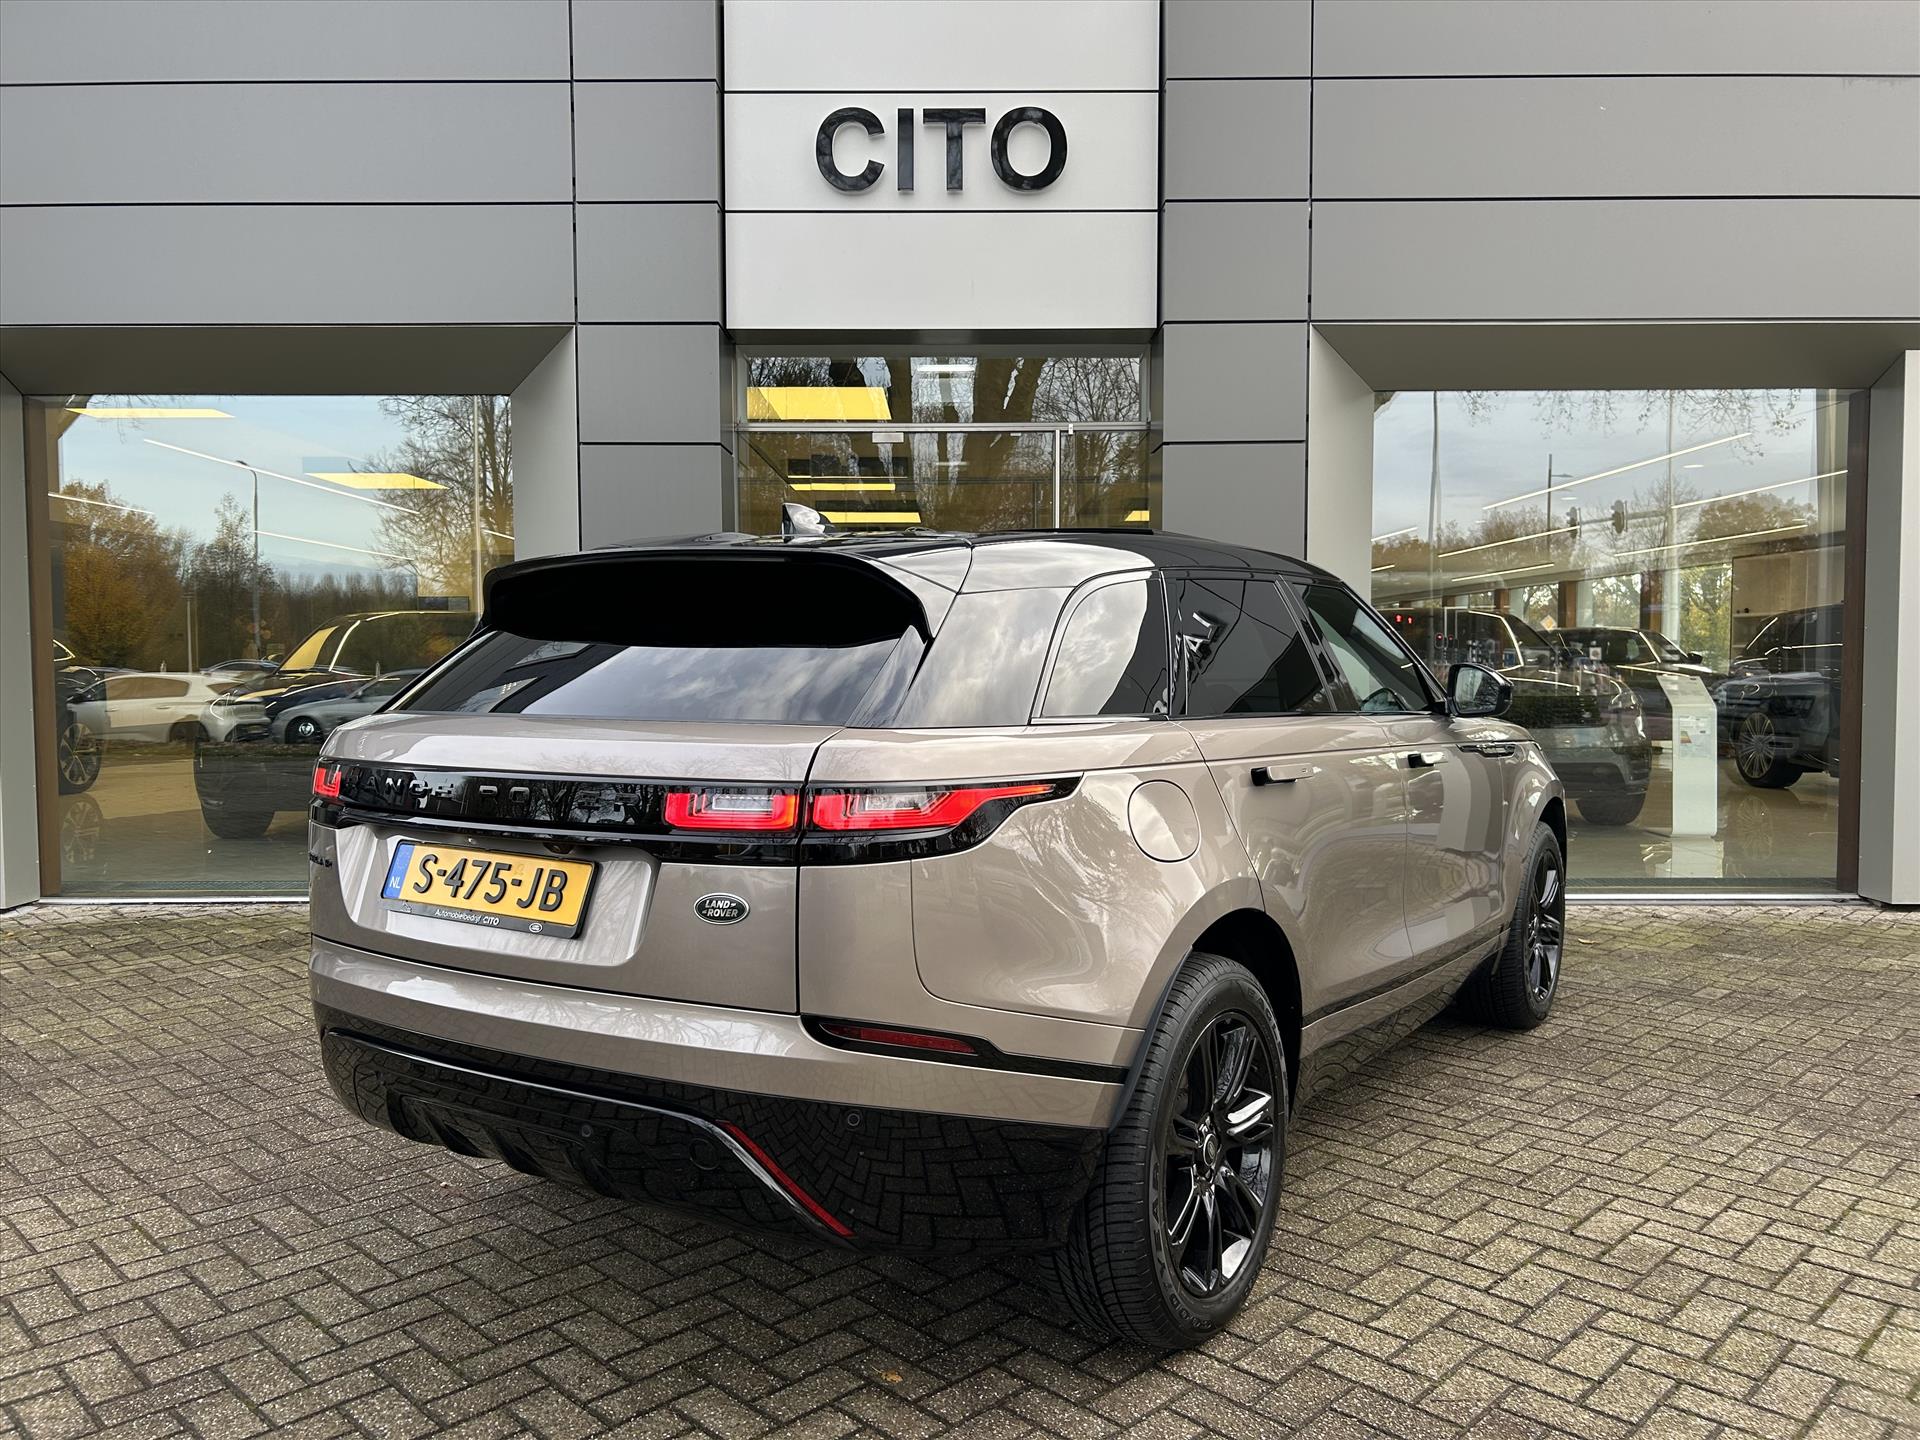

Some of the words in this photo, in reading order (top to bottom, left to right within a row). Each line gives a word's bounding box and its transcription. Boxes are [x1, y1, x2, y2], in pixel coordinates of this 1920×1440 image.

[816, 106, 1068, 191] CITO
[478, 785, 641, 809] ROVER
[390, 876, 400, 888] NL
[413, 854, 569, 912] S-475-JB
[705, 900, 731, 909] LAND
[706, 909, 739, 917] ROVER
[483, 916, 500, 925] CITO
